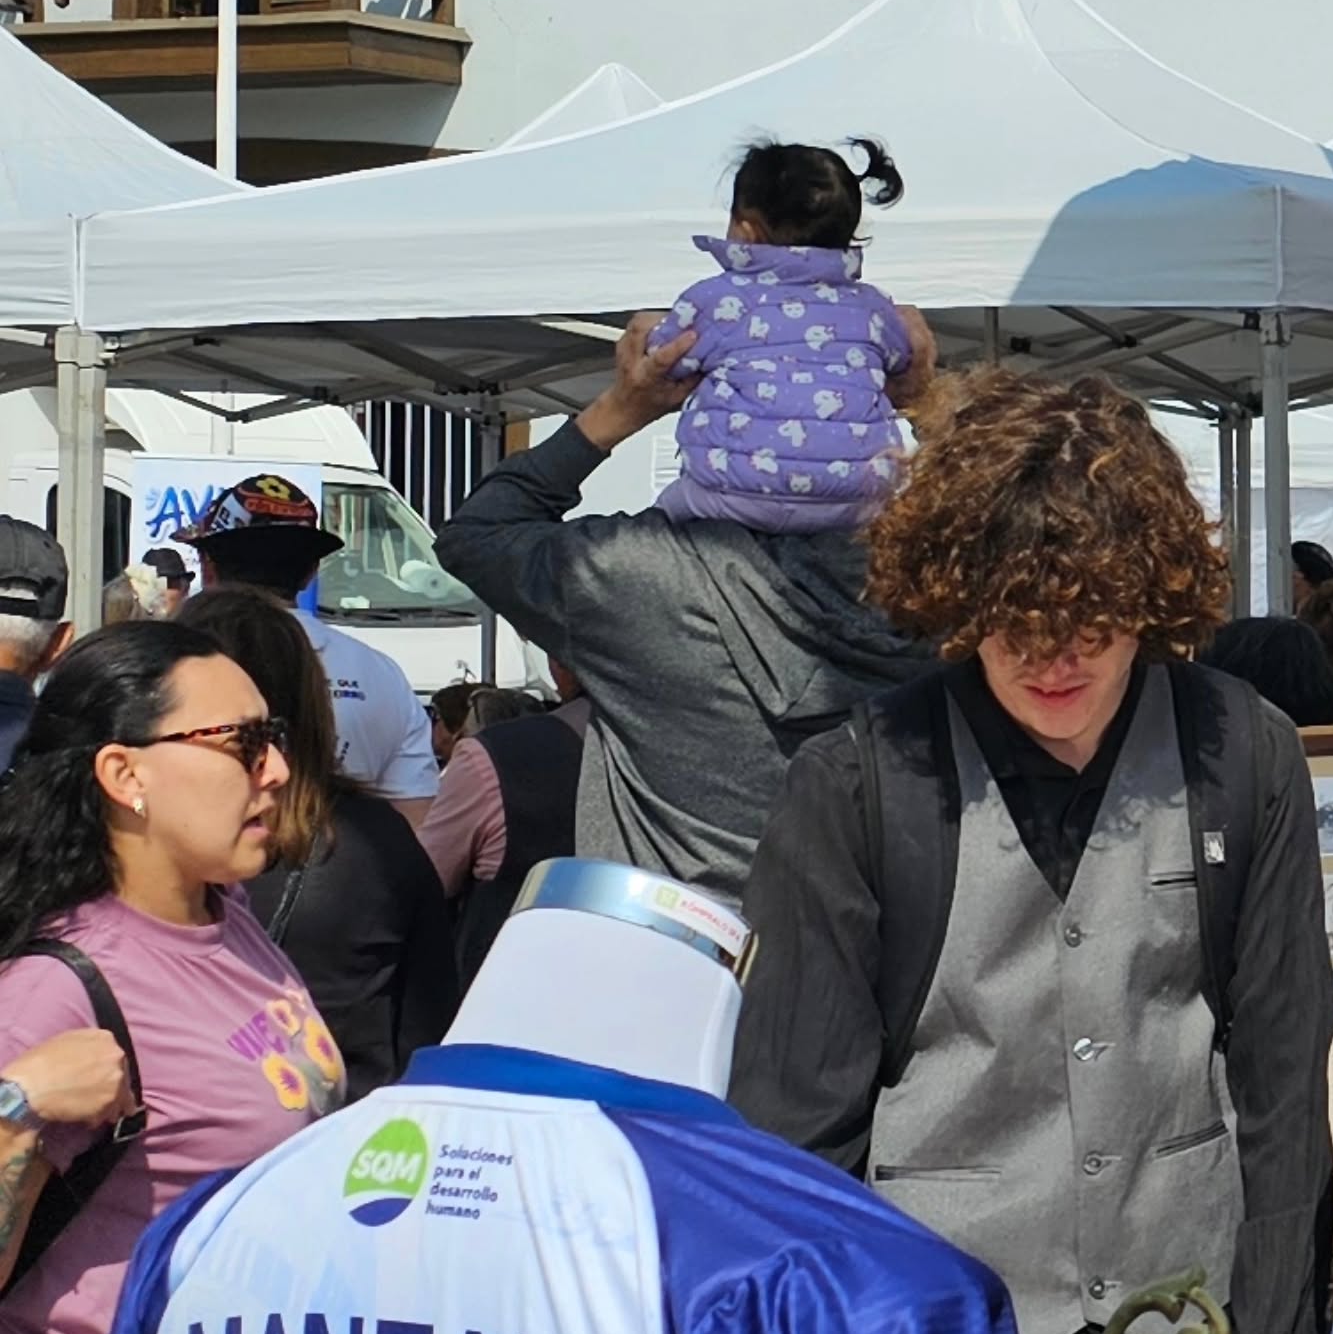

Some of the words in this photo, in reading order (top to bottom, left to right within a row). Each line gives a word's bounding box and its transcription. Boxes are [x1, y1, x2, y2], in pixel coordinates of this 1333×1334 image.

[439, 1143, 514, 1167] Soluciones
[352, 1149, 424, 1186] SQM
[432, 1166, 465, 1181] para
[430, 1182, 499, 1203] desarrollo
[425, 1199, 482, 1220] humano
